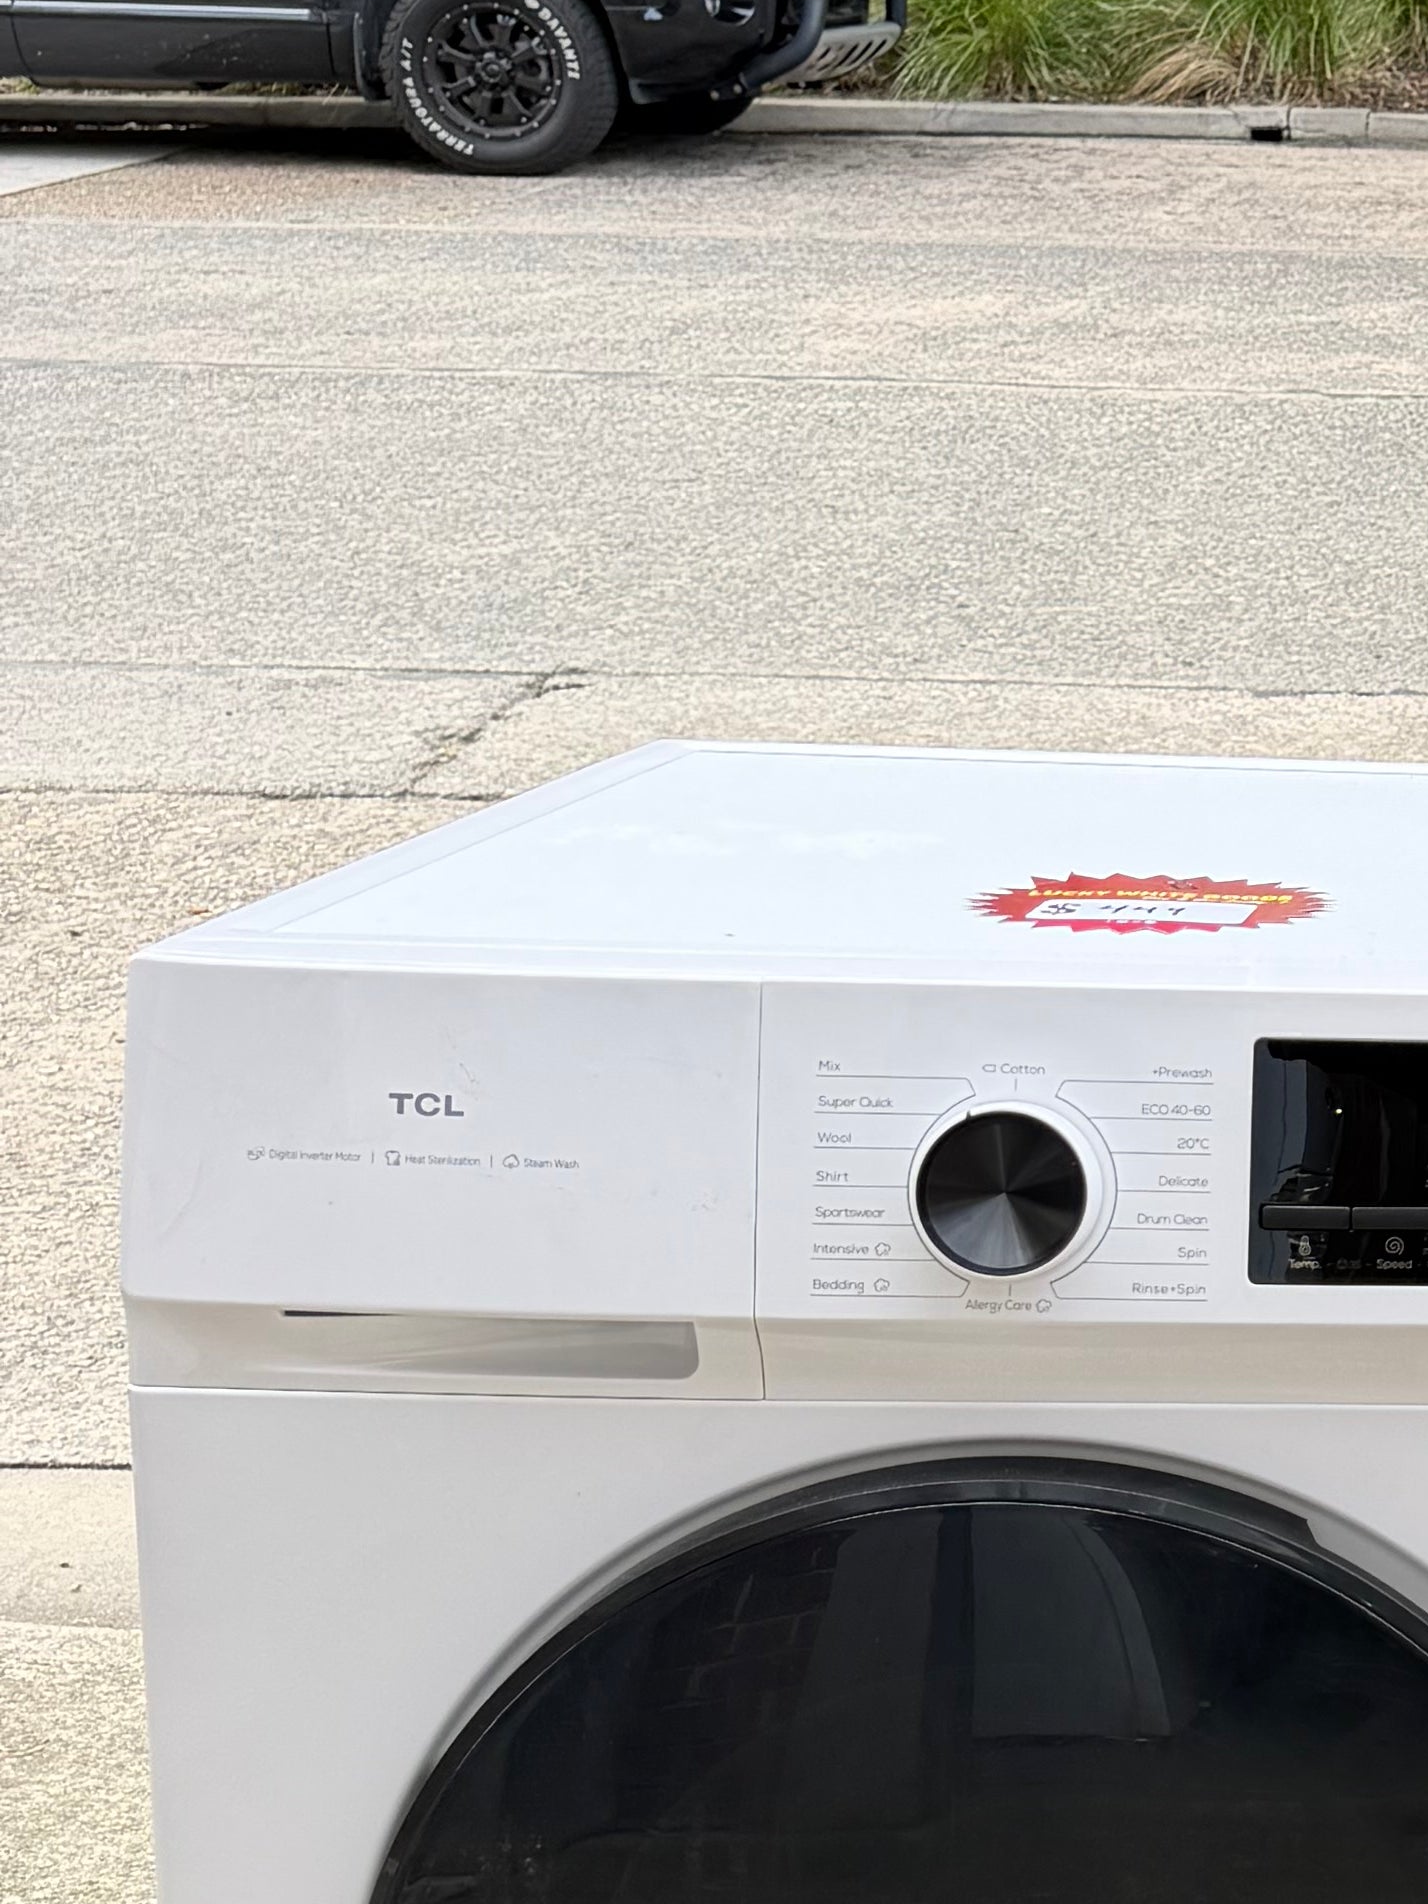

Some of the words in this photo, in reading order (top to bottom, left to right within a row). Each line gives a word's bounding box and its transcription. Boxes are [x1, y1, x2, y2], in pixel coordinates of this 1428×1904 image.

[818, 1060, 841, 1072] Mix
[1000, 1063, 1046, 1075] Cotton
[388, 1092, 465, 1117] TCL
[818, 1095, 856, 1109] Super
[859, 1096, 894, 1108] Quick
[1141, 1103, 1169, 1115] ECO
[1171, 1103, 1212, 1116] 40-60
[817, 1131, 852, 1144] Wool
[269, 1148, 298, 1161] Digital
[405, 1154, 426, 1165] Heat
[524, 1158, 552, 1168] Steam
[554, 1159, 580, 1169] Wash
[816, 1170, 849, 1182] Shirt
[1158, 1175, 1209, 1188] Delicate
[815, 1206, 886, 1219] Sportswear
[1137, 1212, 1171, 1225] Drum
[1173, 1213, 1208, 1225] Clean
[813, 1243, 870, 1255] Intensive
[1177, 1246, 1208, 1259] Spin
[1288, 1258, 1323, 1271] Temp.
[1376, 1258, 1413, 1271] Speed
[812, 1278, 866, 1294] Bedding
[1004, 1299, 1032, 1311] Care
